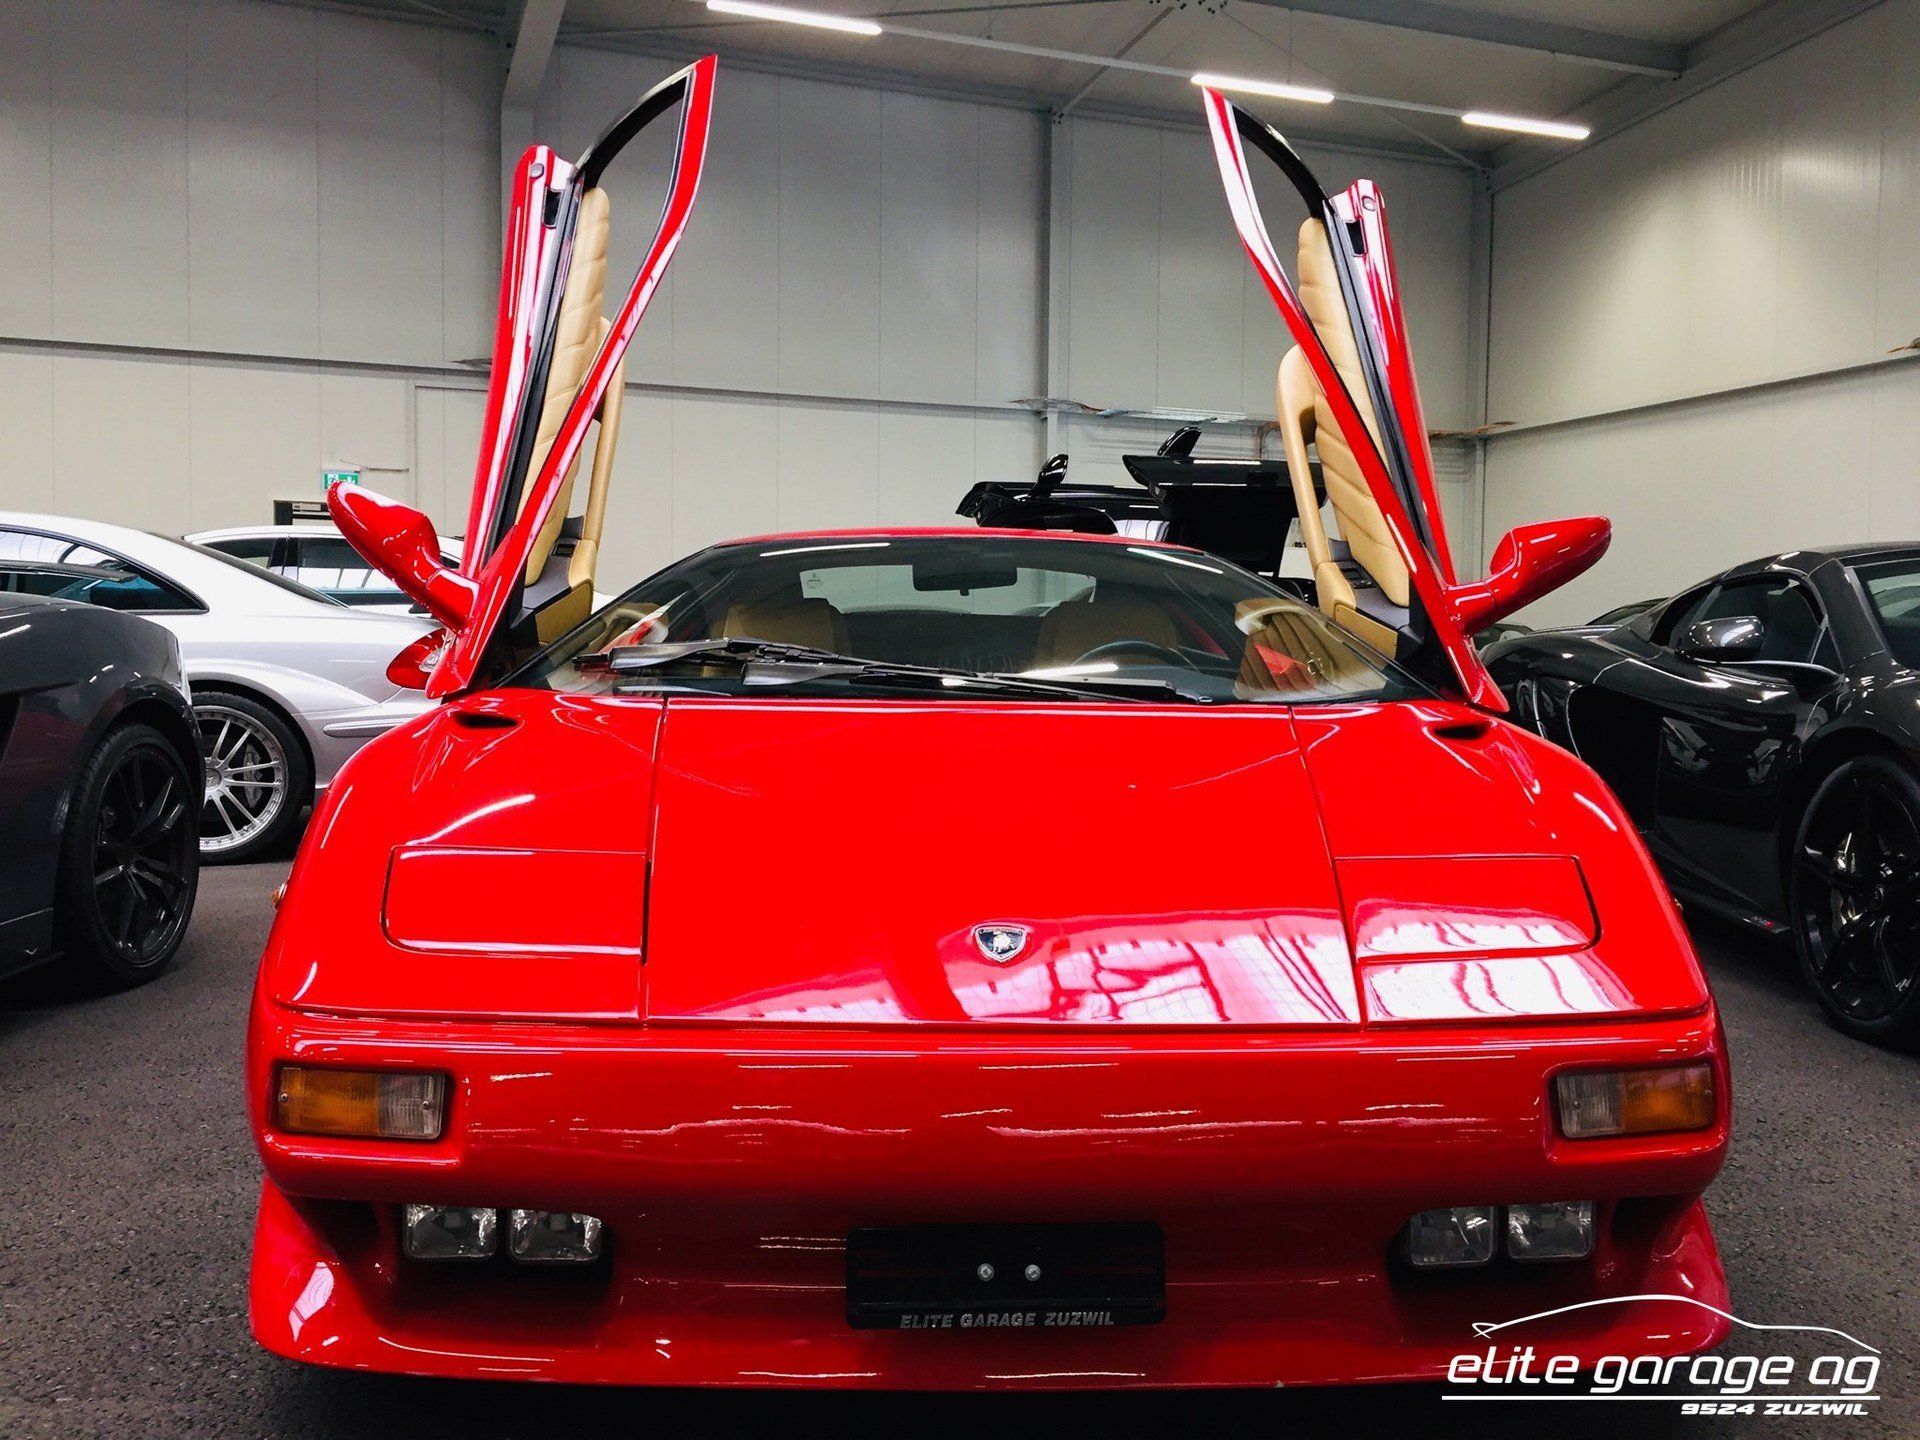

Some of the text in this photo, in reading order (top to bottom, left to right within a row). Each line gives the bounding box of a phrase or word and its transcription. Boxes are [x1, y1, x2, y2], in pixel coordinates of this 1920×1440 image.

[900, 1311, 1114, 1329] ELITE GARAGE ZUZWIL
